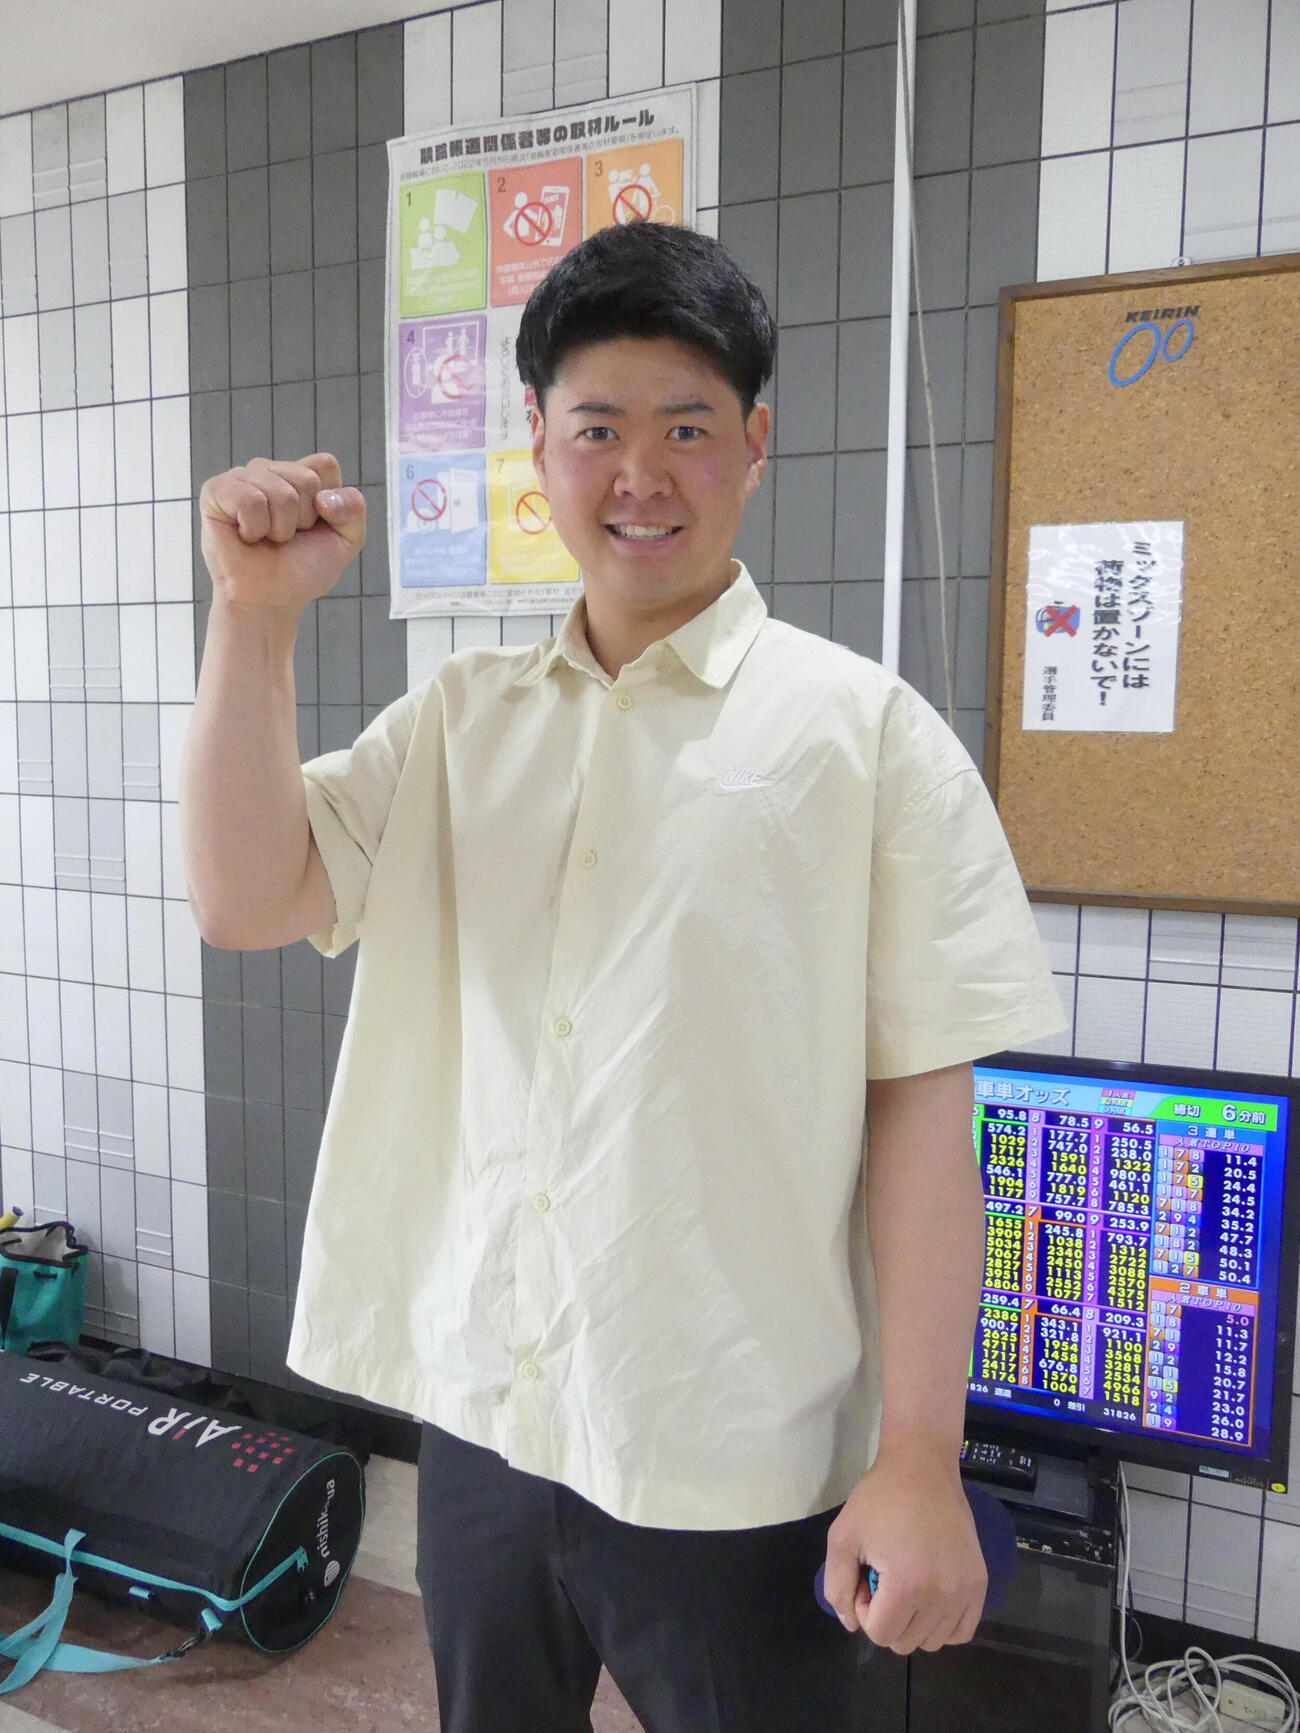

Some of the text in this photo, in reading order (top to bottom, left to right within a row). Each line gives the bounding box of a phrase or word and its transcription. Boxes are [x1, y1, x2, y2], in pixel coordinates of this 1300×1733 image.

[594, 161, 604, 177] 3
[497, 177, 506, 193] 2
[405, 191, 412, 206] 1
[1125, 304, 1200, 322] KEIRIN
[406, 330, 415, 345] 4
[406, 464, 415, 480] 6
[496, 458, 505, 474] 7
[1122, 541, 1156, 688] ミックスゾーンには
[998, 1108, 1027, 1121] 95.8
[1031, 1112, 1089, 1127] 8 78.5
[988, 1123, 1025, 1136] 574.2
[1094, 1119, 1153, 1135] 9 56.5
[991, 1133, 1025, 1146] 1029
[1050, 1130, 1088, 1142] 177.7
[991, 1143, 1025, 1157] 1717
[1049, 1140, 1087, 1153] 747.0
[1112, 1137, 1152, 1150] 250.5
[990, 1154, 1024, 1167] 2326
[1053, 1151, 1087, 1164] 1591
[1111, 1147, 1152, 1161] 238.0
[1225, 1154, 1257, 1167] 11.4
[986, 1164, 1024, 1177] 546.1
[1053, 1161, 1086, 1174] 1640
[1115, 1158, 1151, 1172] 1322
[1047, 1172, 1086, 1185] 777.0
[1110, 1169, 1151, 1182] 980.0
[1224, 1167, 1256, 1180] 20.5
[990, 1175, 1024, 1188] 1904
[1052, 1182, 1086, 1195] 1819
[1110, 1179, 1150, 1193] 461.1
[1223, 1180, 1256, 1193] 24.4
[989, 1185, 1023, 1198] 1177
[1114, 1190, 1150, 1204] 1120
[1046, 1193, 1085, 1206] 757.7
[1223, 1193, 1255, 1206] 24.5
[986, 1201, 1024, 1215] 497.2
[1028, 1206, 1085, 1223] 7 99.0
[1109, 1201, 1149, 1215] 785.3
[1222, 1206, 1254, 1219] 34.2
[988, 1216, 1022, 1229] 1655
[1028, 1221, 1084, 1238] 1 245.8
[1090, 1215, 1149, 1231] 9 253.9
[1221, 1219, 1253, 1232] 35.2
[987, 1226, 1021, 1239] 3909
[1027, 1231, 1083, 1248] 2 1038
[1090, 1230, 1147, 1247] 1 793.7
[1221, 1232, 1253, 1245] 47.7
[986, 1237, 1021, 1250] 5034
[1027, 1242, 1083, 1259] 3 2340
[1089, 1240, 1147, 1257] 2 1312
[986, 1247, 1021, 1260] 7067
[1220, 1245, 1252, 1258] 48.3
[986, 1257, 1020, 1270] 2827
[1027, 1252, 1082, 1269] 4 2450
[1089, 1251, 1146, 1268] 3 2722
[1219, 1258, 1251, 1271] 50.1
[985, 1268, 1020, 1281] 3951
[1026, 1262, 1082, 1279] 5 1113
[1088, 1261, 1146, 1279] 4 3088
[985, 1278, 1020, 1291] 6806
[1026, 1273, 1081, 1290] 6 2552
[1088, 1272, 1145, 1290] 5 2570
[1219, 1271, 1250, 1284] 50.4
[1025, 1283, 1081, 1300] 9 1077
[1087, 1282, 1145, 1300] 6 4375
[983, 1293, 1019, 1307] 259.4
[1087, 1293, 1144, 1311] 7 1512
[984, 1308, 1019, 1321] 2386
[1025, 1299, 1080, 1317] 7 66.4
[980, 1318, 1018, 1332] 900.7
[1024, 1314, 1079, 1331] 1 343.1
[1085, 1309, 1144, 1327] 8 209.3
[1226, 1314, 1249, 1326] 5.0
[983, 1328, 1018, 1342] 2625
[1023, 1324, 1078, 1342] 2 321.8
[1101, 1328, 1142, 1342] 921.1
[1216, 1326, 1248, 1339] 11.3
[983, 1338, 1017, 1352] 4711
[1023, 1335, 1078, 1352] 3 1954
[1105, 1338, 1142, 1353] 1100
[1216, 1338, 1248, 1352] 11.7
[983, 1348, 1017, 1363] 1717
[1023, 1345, 1078, 1363] 4 1458
[1104, 1349, 1142, 1364] 3568
[1215, 1351, 1247, 1364] 12.2
[982, 1359, 1017, 1373] 2417
[1022, 1355, 1078, 1373] 5 676.8
[1104, 1359, 1142, 1374] 3281
[1214, 1364, 1247, 1377] 15.8
[981, 1369, 1016, 1383] 5176
[1022, 1365, 1078, 1384] 6 1570
[1103, 1370, 1141, 1385] 2534
[1022, 1376, 1077, 1394] 8 1004
[1103, 1380, 1141, 1396] 4966
[1214, 1376, 1246, 1390] 20.7
[20, 1373, 149, 1416] PORTABLE
[1104, 1391, 1141, 1406] 1518
[1213, 1389, 1245, 1403] 21.7
[1103, 1407, 1137, 1421] 31826
[1212, 1402, 1245, 1416] 23.0
[1212, 1415, 1244, 1428] 26.0
[1211, 1427, 1244, 1441] 28.9
